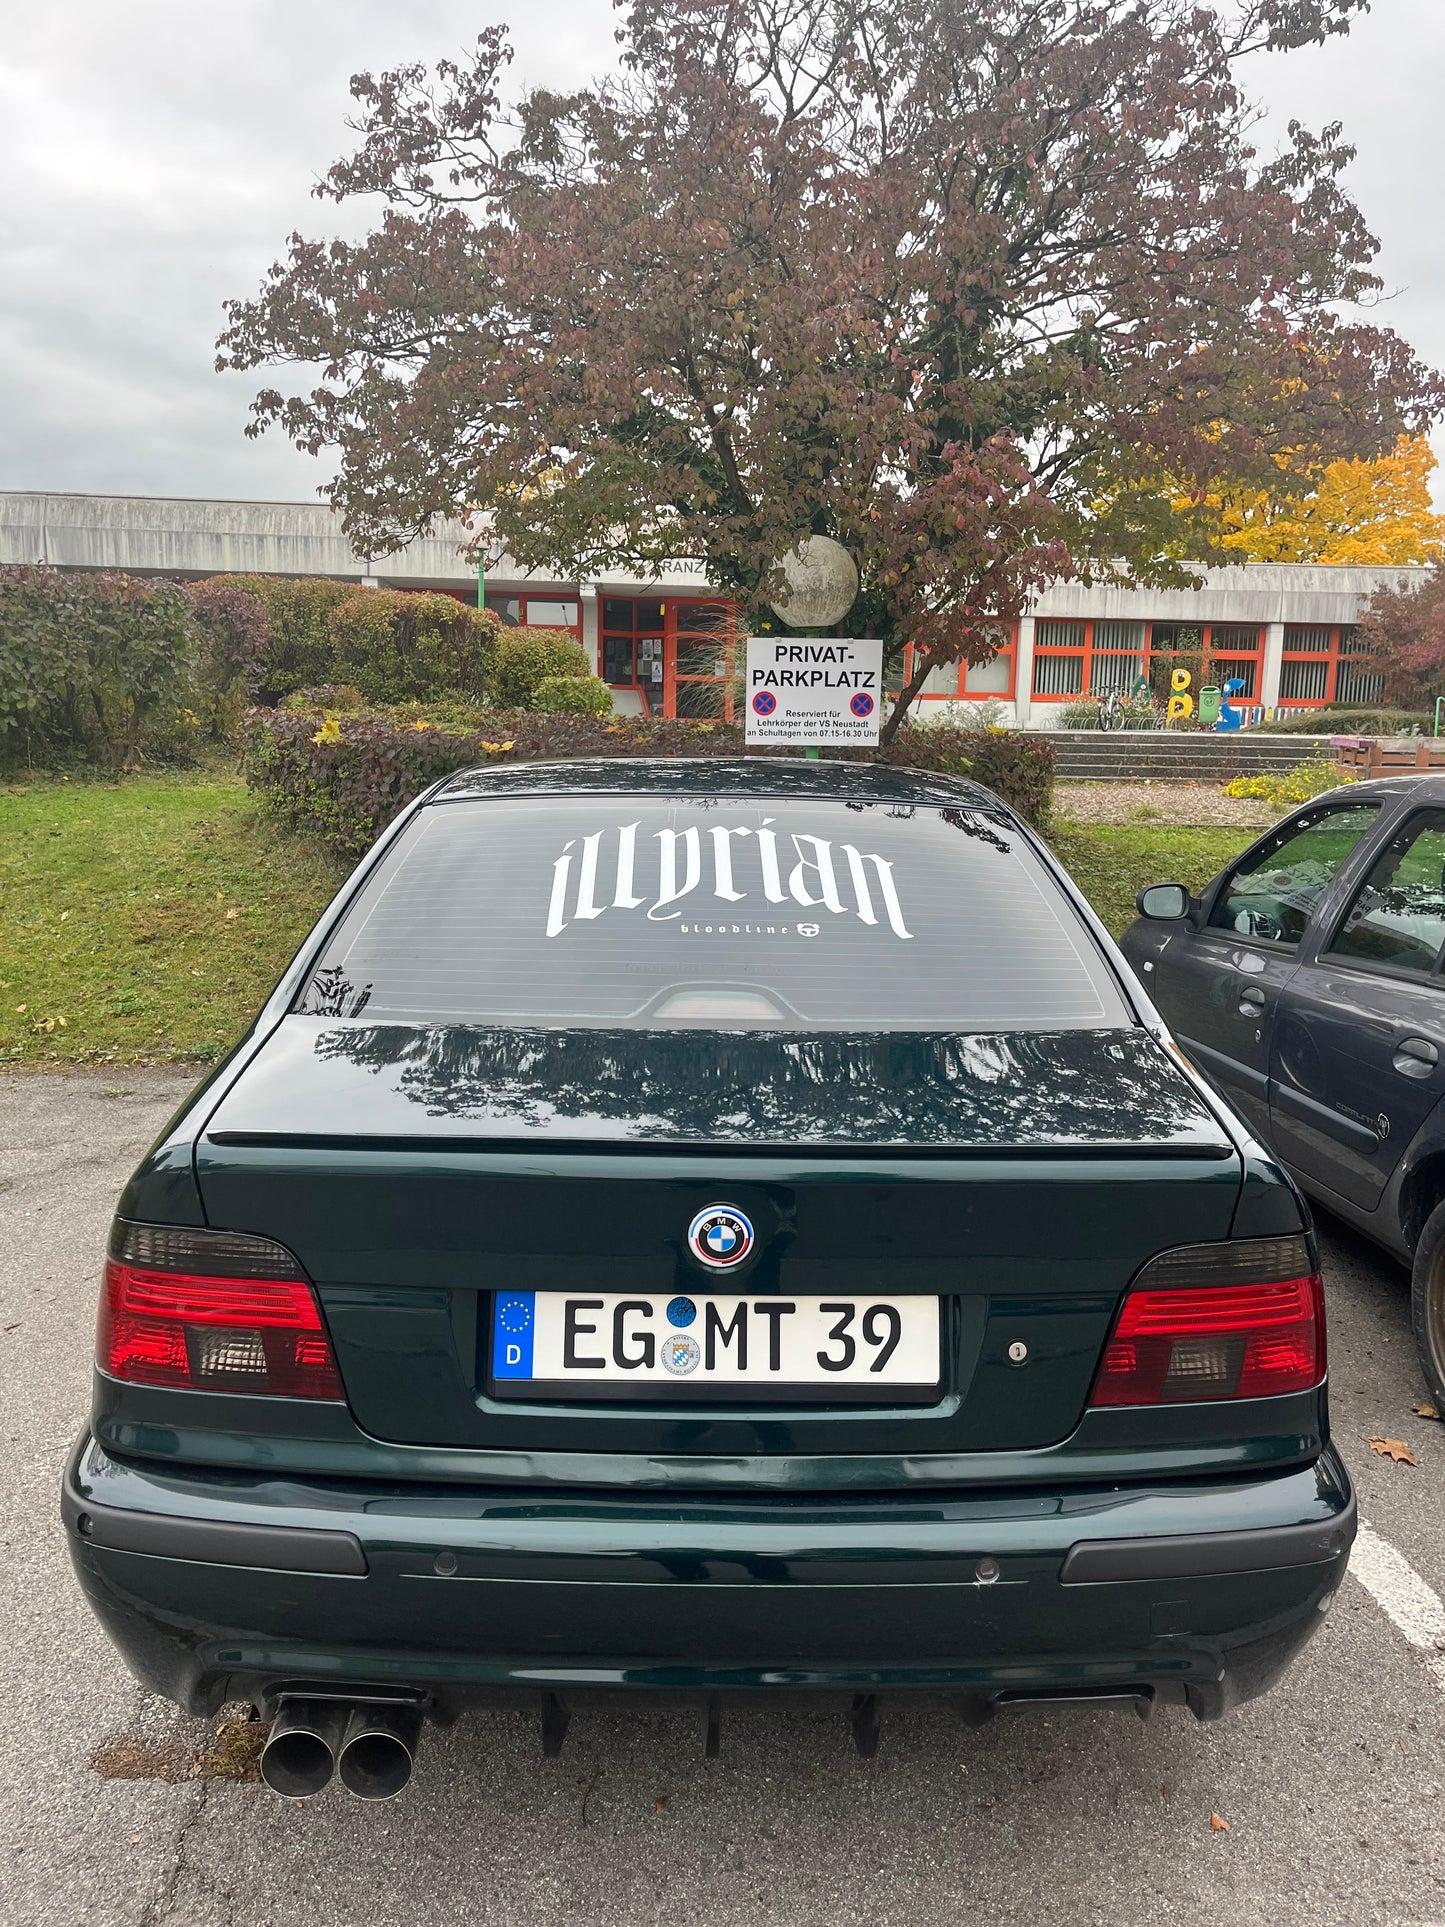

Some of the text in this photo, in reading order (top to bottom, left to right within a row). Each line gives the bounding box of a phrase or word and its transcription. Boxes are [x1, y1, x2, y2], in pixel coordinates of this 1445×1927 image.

[775, 645, 855, 663] PRIVAT-
[752, 669, 875, 688] PARKPLATZ
[785, 709, 841, 718] Reserviert für
[757, 719, 869, 728] Lehrkörper der VS Neustadt
[758, 729, 802, 738] Schultagen
[863, 730, 878, 738] Uhr
[680, 924, 789, 934] bloodline
[702, 1217, 742, 1232] BMW
[563, 1300, 656, 1370] EG
[705, 1301, 796, 1371] MT
[816, 1303, 902, 1373] 39
[506, 1344, 521, 1365] D
